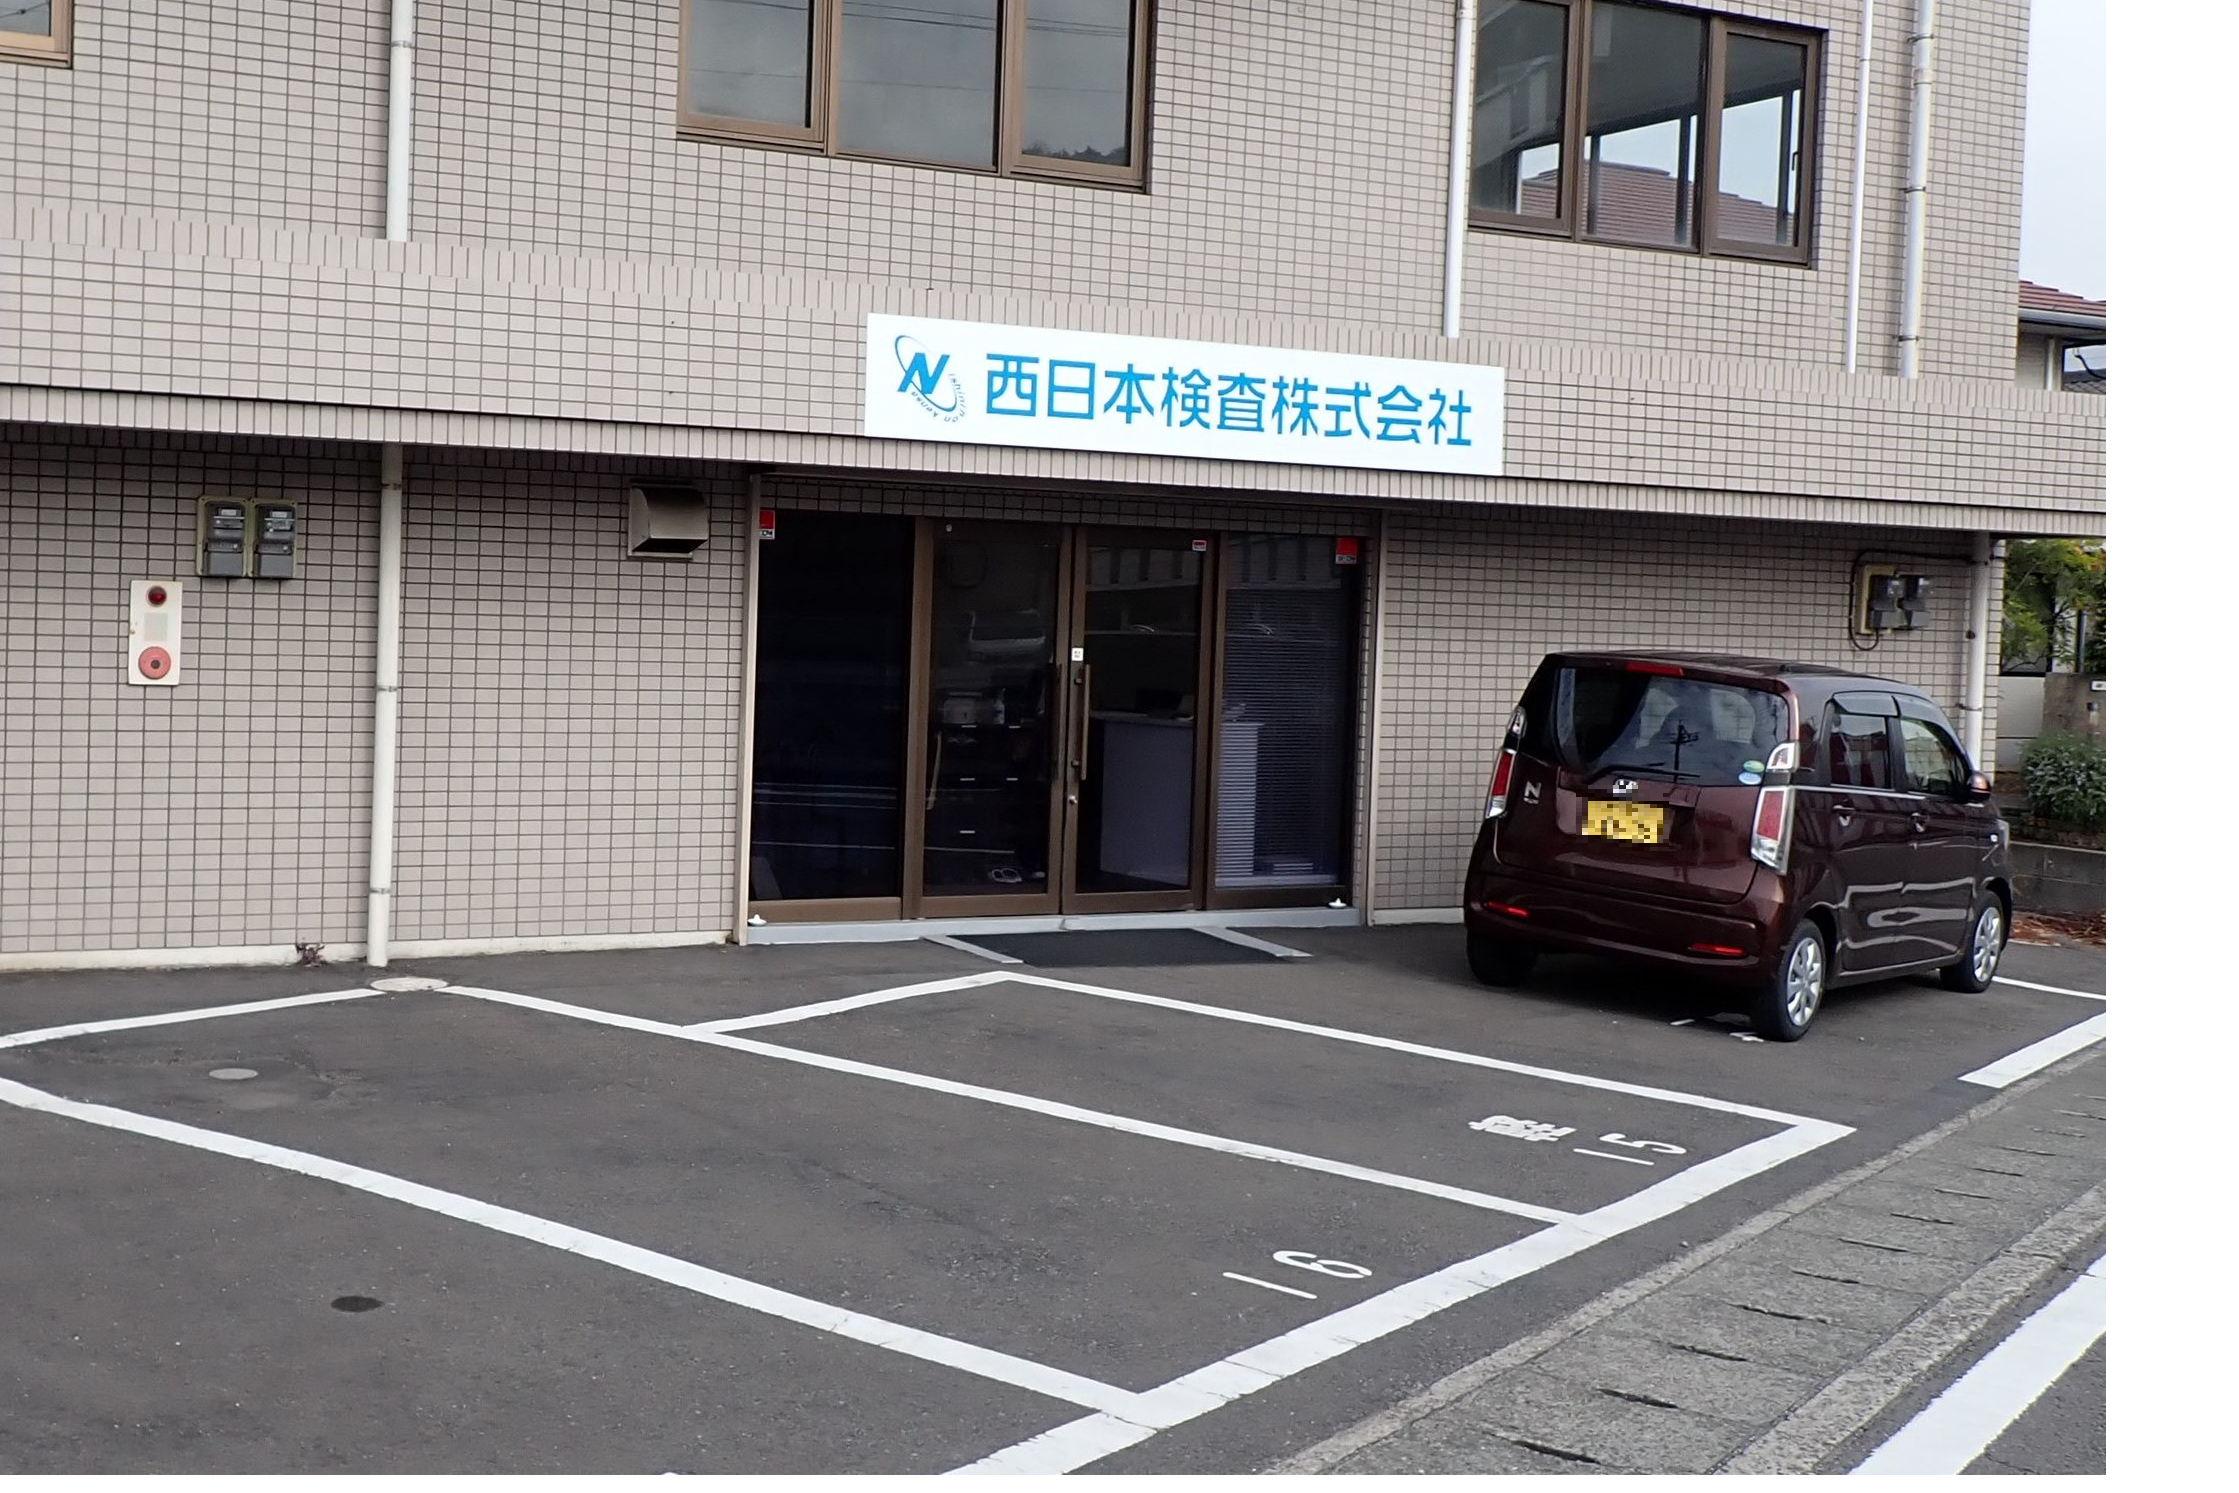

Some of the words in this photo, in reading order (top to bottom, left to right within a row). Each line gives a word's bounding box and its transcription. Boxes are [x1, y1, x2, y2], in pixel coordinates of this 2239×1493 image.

[986, 352, 1472, 447] 西日本検査株式会社
[1573, 1133, 1687, 1166] 15
[1222, 1250, 1373, 1300] 16
